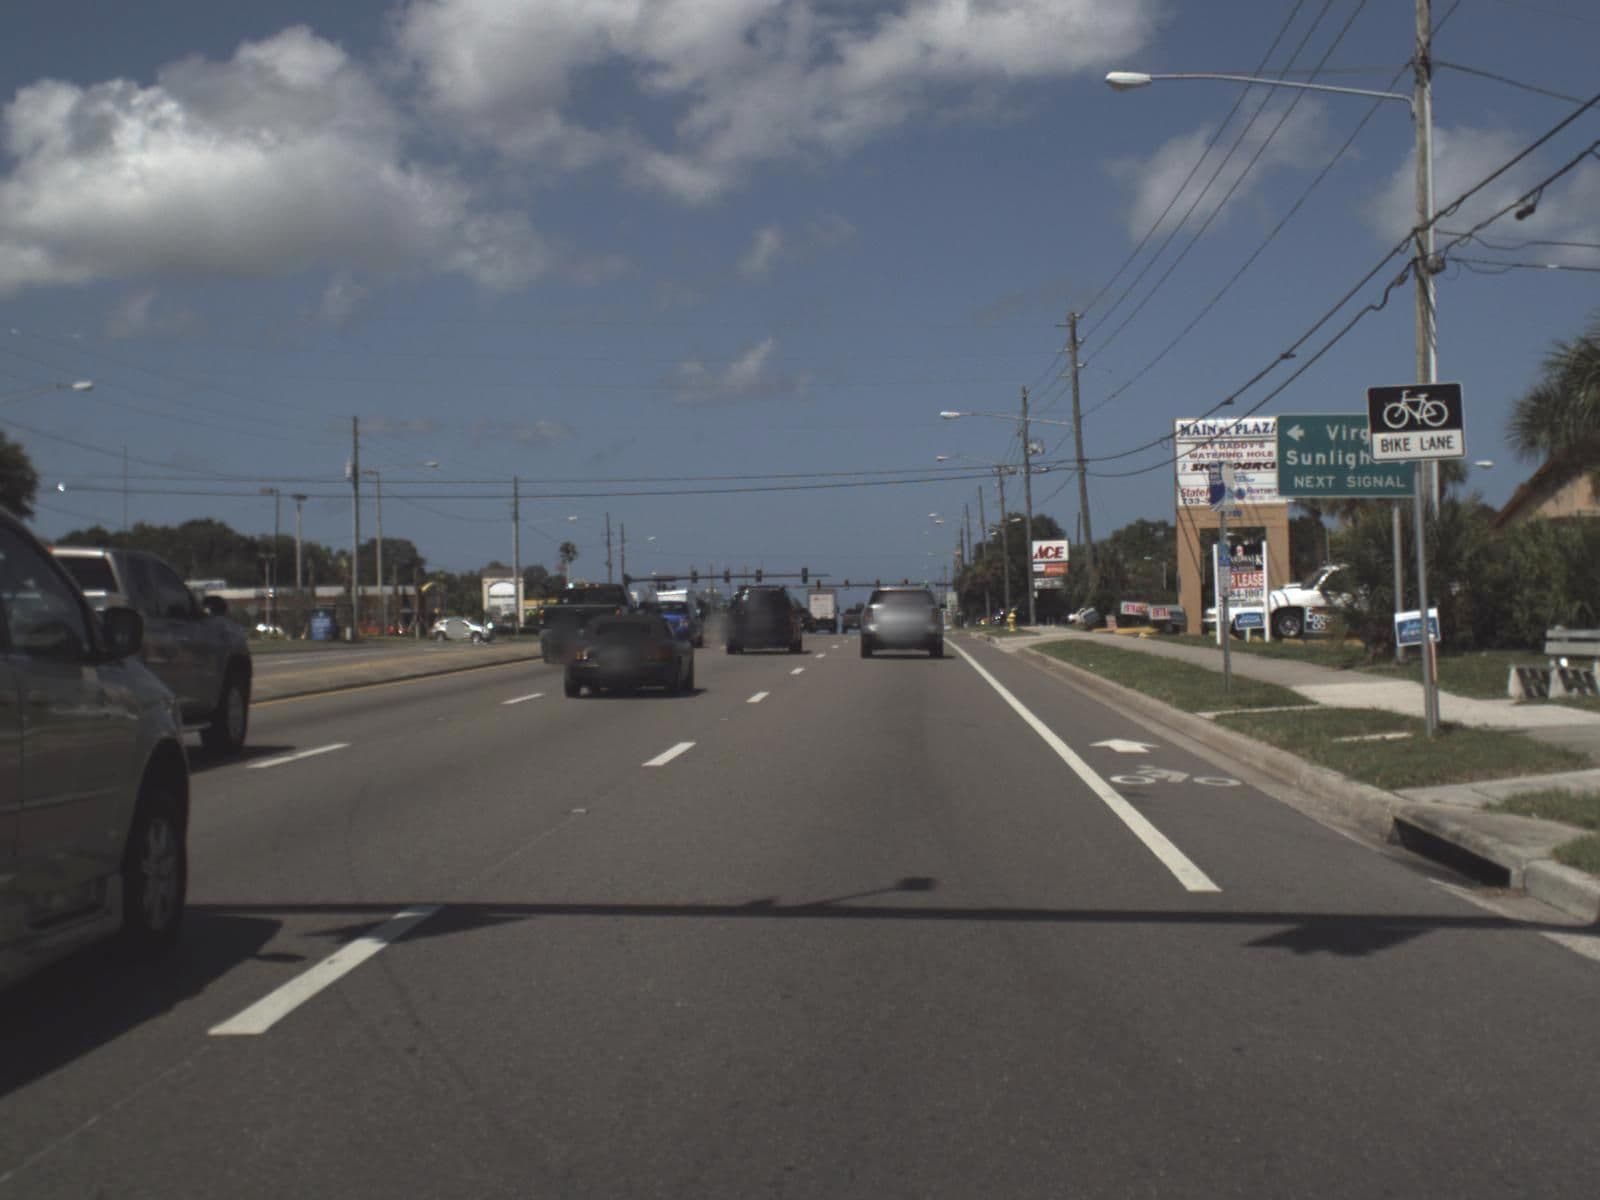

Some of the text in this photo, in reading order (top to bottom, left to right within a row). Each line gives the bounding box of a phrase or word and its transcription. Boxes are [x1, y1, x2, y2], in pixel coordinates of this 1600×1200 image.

[1181, 424, 1216, 435] MAIN
[1326, 425, 1369, 446] Virg
[1381, 435, 1454, 453] BIKE LANE
[1286, 450, 1373, 469] Sunligh
[1294, 476, 1406, 488] NEXT SIGNAL
[1033, 545, 1064, 559] ACE
[1238, 573, 1264, 588] LEASE
